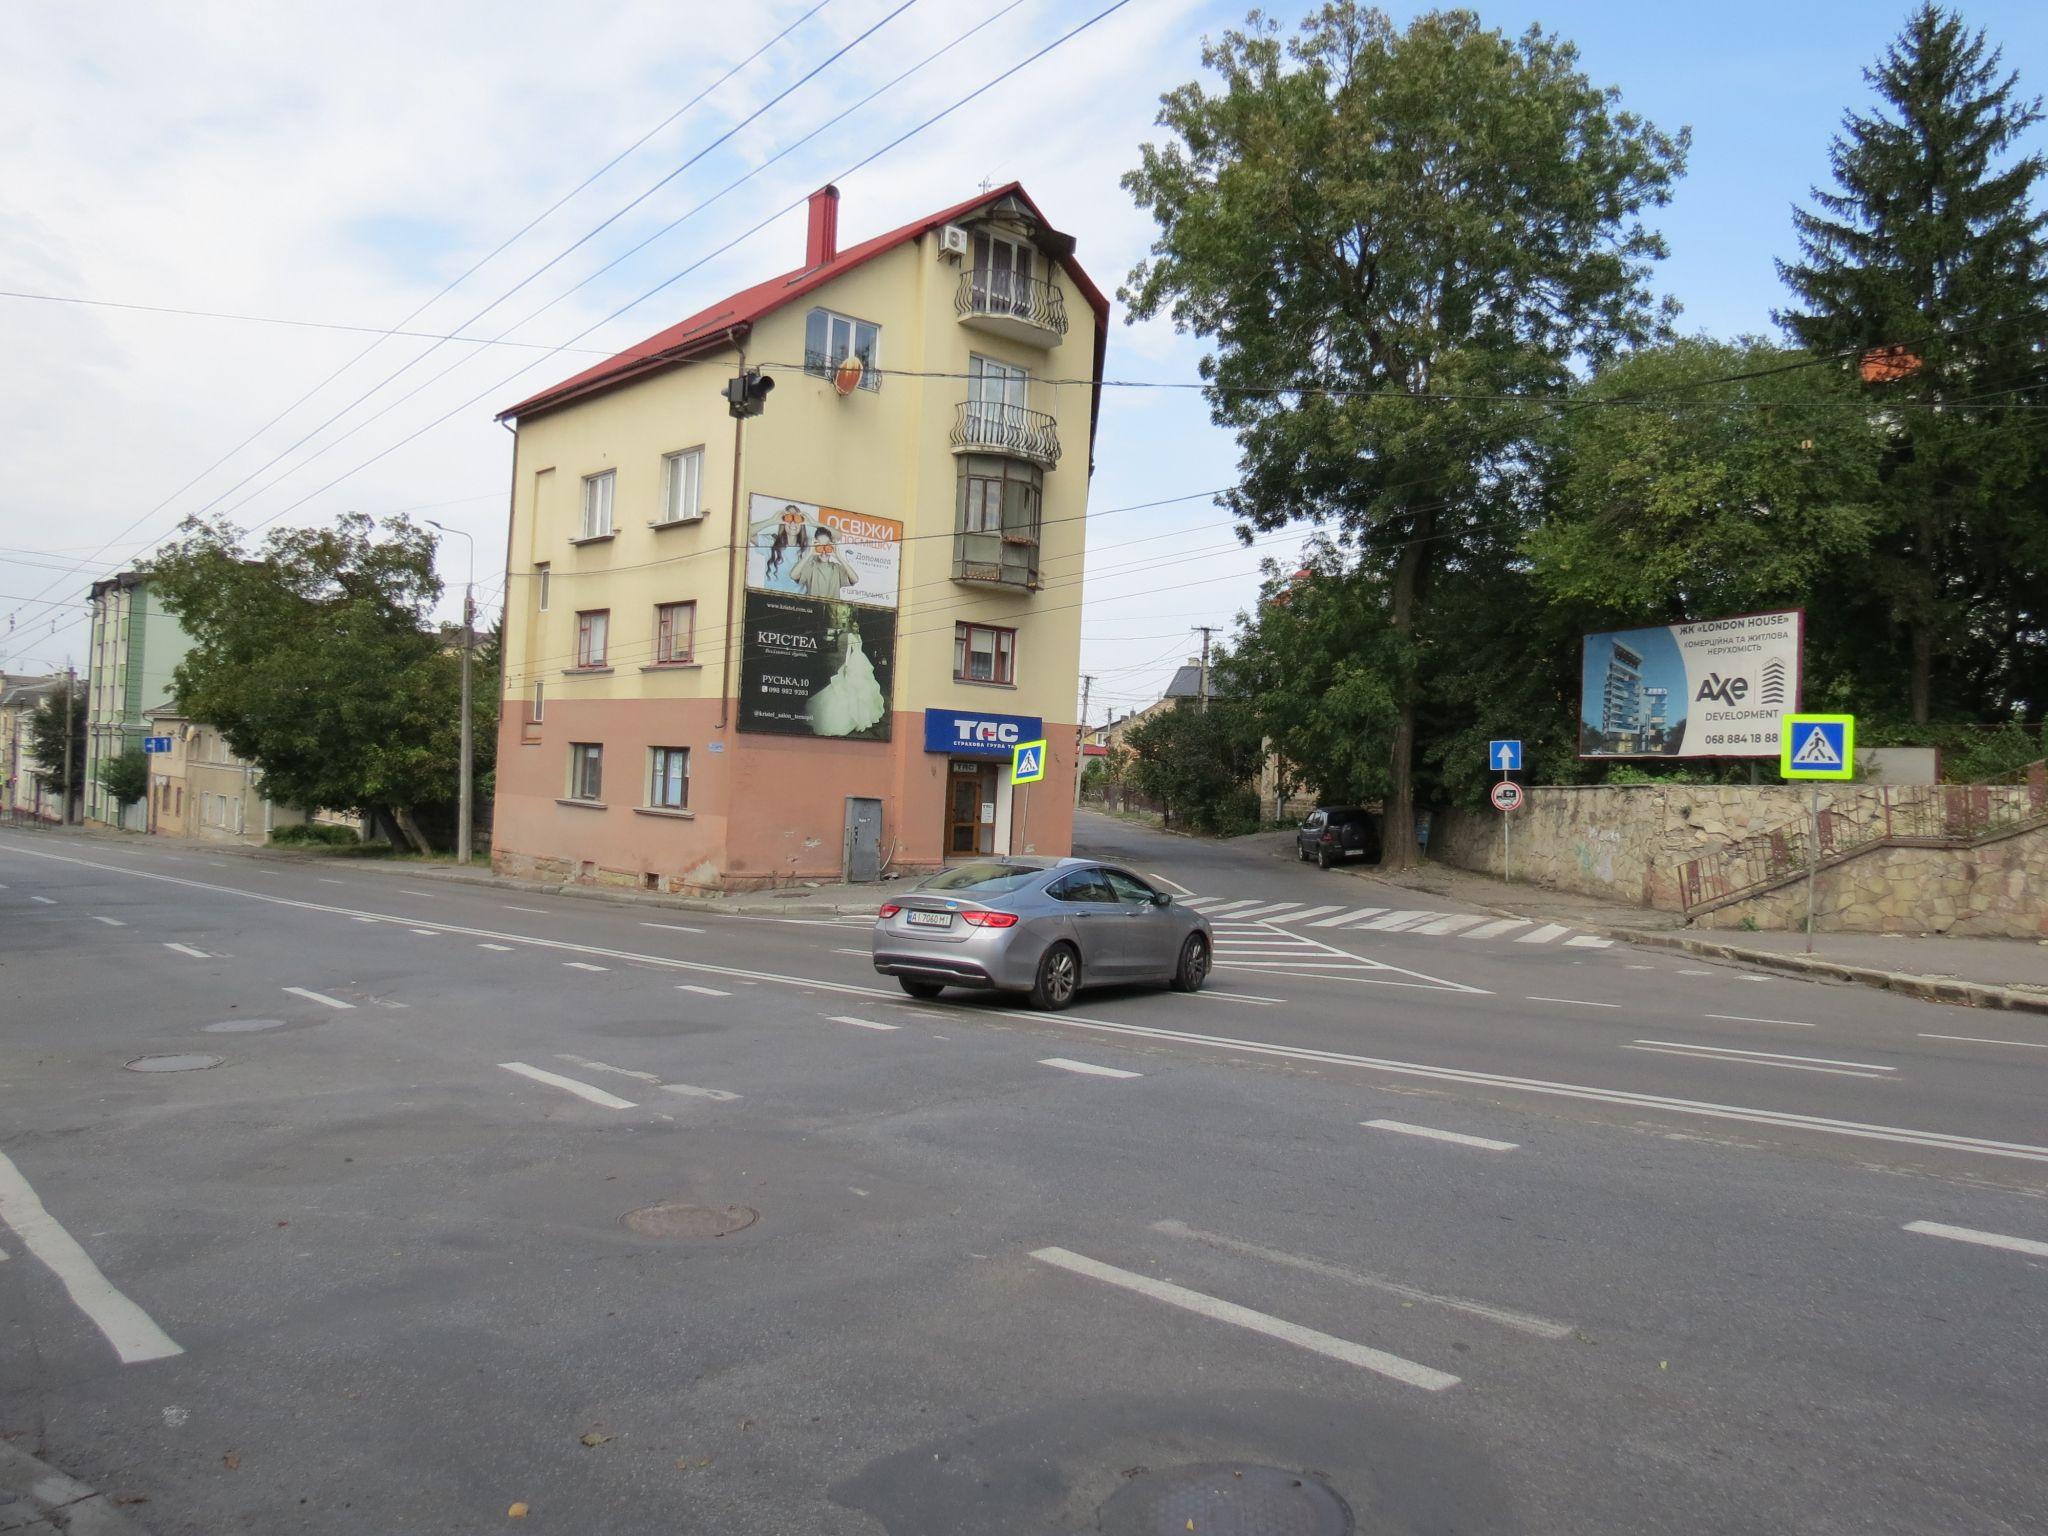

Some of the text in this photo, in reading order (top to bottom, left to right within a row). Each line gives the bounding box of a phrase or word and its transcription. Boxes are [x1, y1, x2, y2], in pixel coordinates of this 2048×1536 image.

[827, 515, 894, 541] ОСВІЖИ
[856, 552, 892, 565] Допомога
[1680, 626, 1695, 636] ЖК
[758, 631, 818, 649] КРІСТЕЛ
[1684, 631, 1789, 649] КОМЕРЦІЙНА ТА ЖИТЛОВА
[1707, 644, 1762, 656] НЕРУХОМІСТЬ
[1705, 709, 1779, 721] DEVELOPMENT
[1705, 733, 1778, 744] 068 884 18 88
